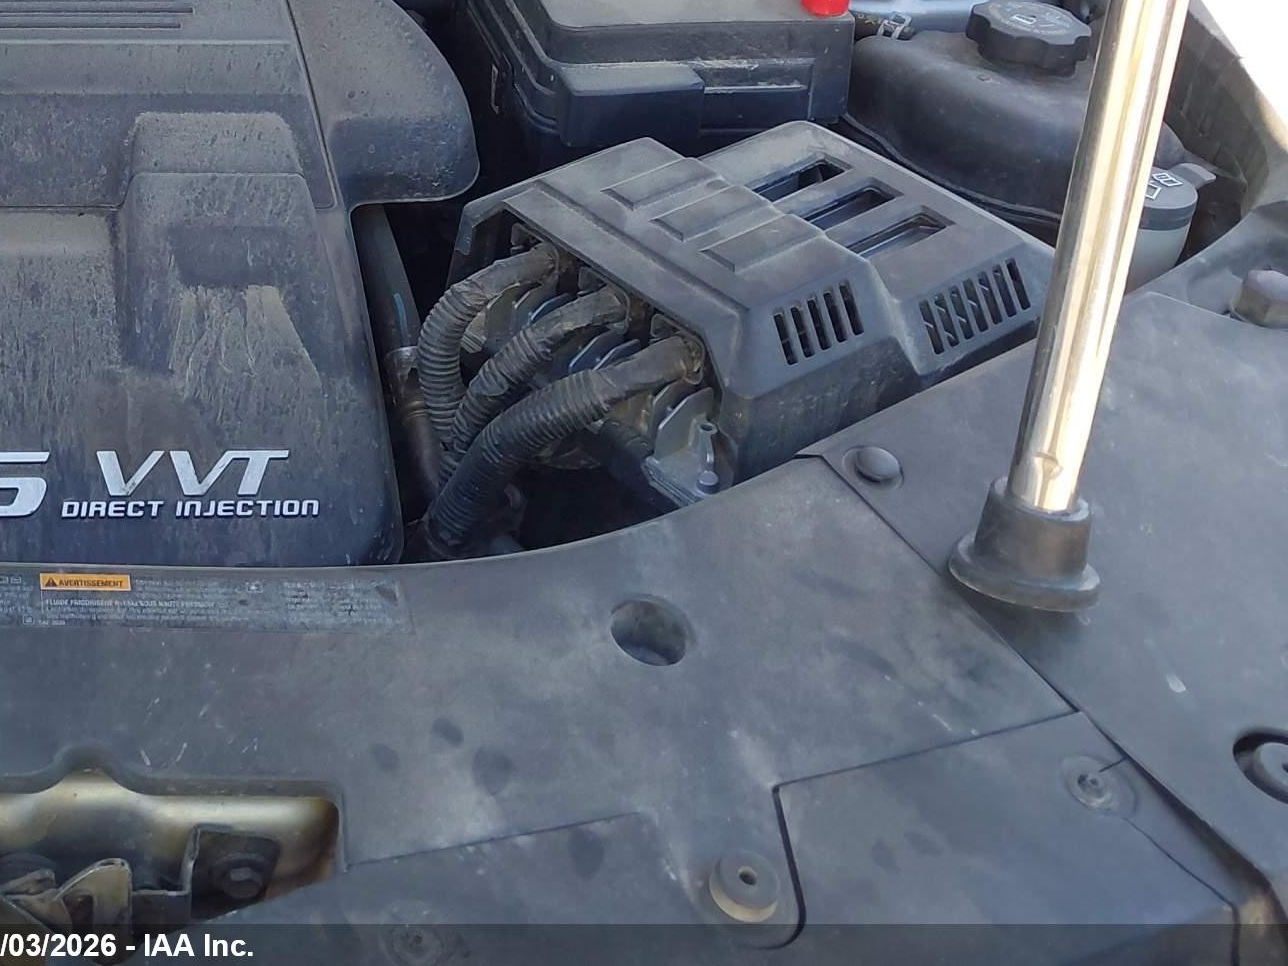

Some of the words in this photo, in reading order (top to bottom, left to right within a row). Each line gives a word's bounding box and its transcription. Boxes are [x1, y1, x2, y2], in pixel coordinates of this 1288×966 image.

[95, 449, 290, 497] VVT
[61, 499, 164, 519] DIRECT
[175, 499, 320, 518] INJECTION
[59, 578, 124, 588] AVERTISSEMENT
